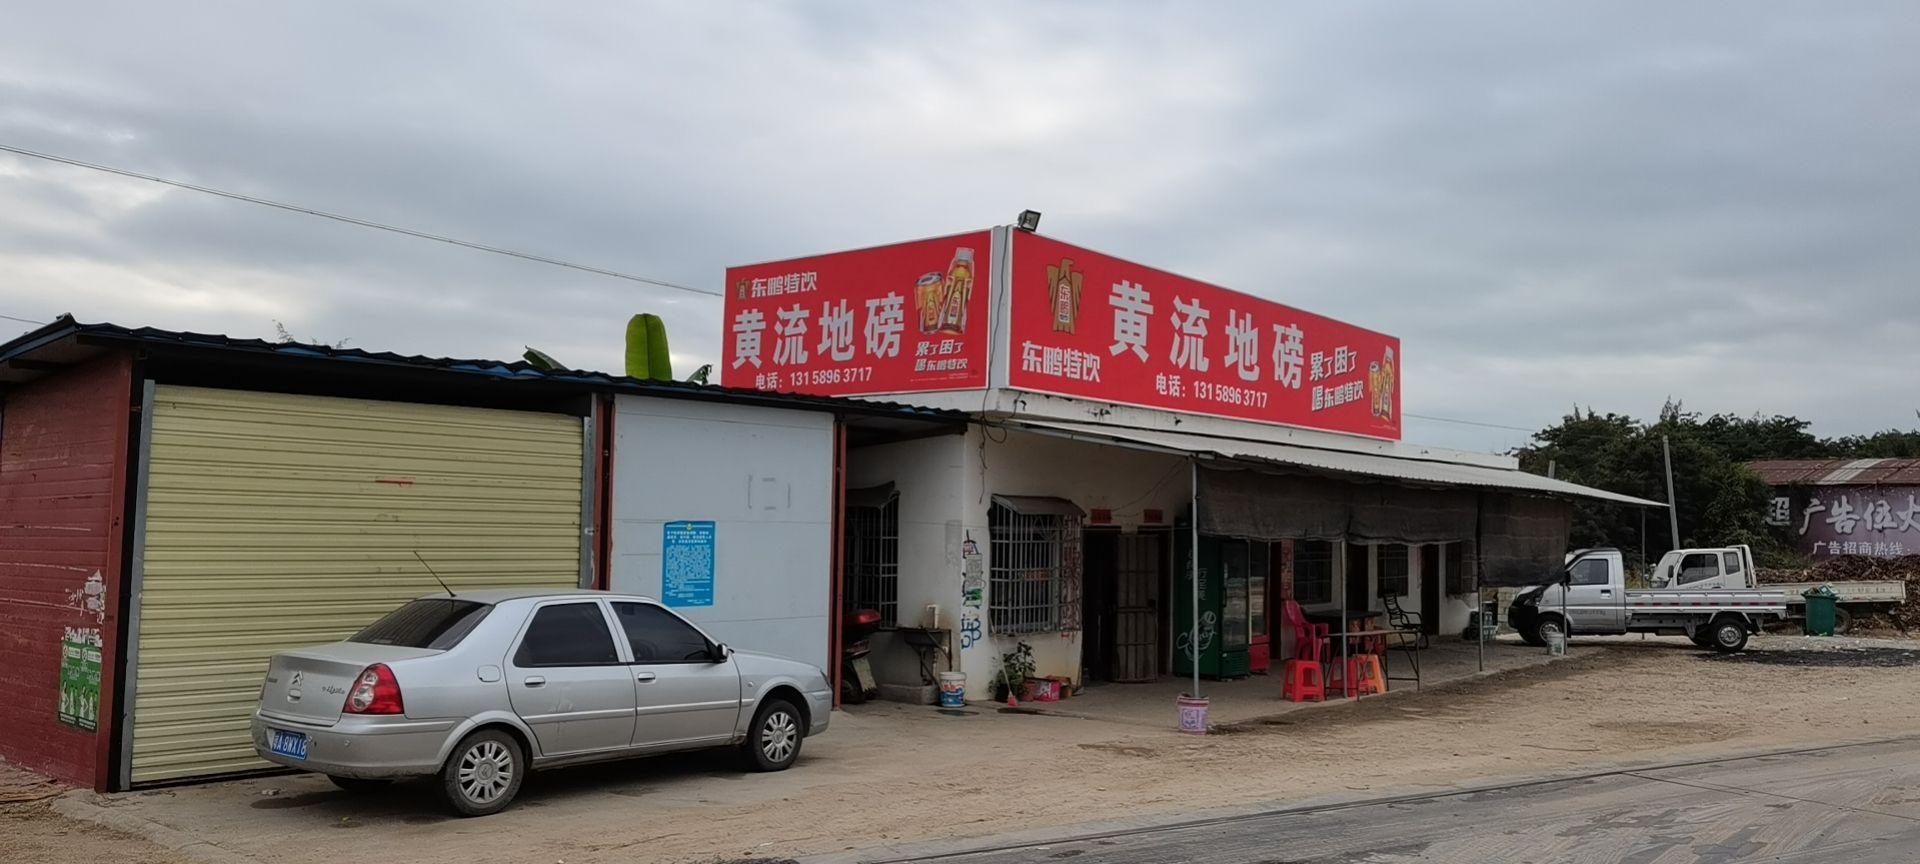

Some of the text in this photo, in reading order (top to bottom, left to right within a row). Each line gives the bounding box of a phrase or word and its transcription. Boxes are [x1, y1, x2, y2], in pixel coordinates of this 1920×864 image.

[752, 272, 817, 298] 东鹏特饮
[732, 291, 904, 369] 黄流地磅
[1109, 280, 1304, 389] 黄流地磅
[1022, 340, 1100, 382] 东鹏特饮
[1309, 345, 1358, 382] 累了困了
